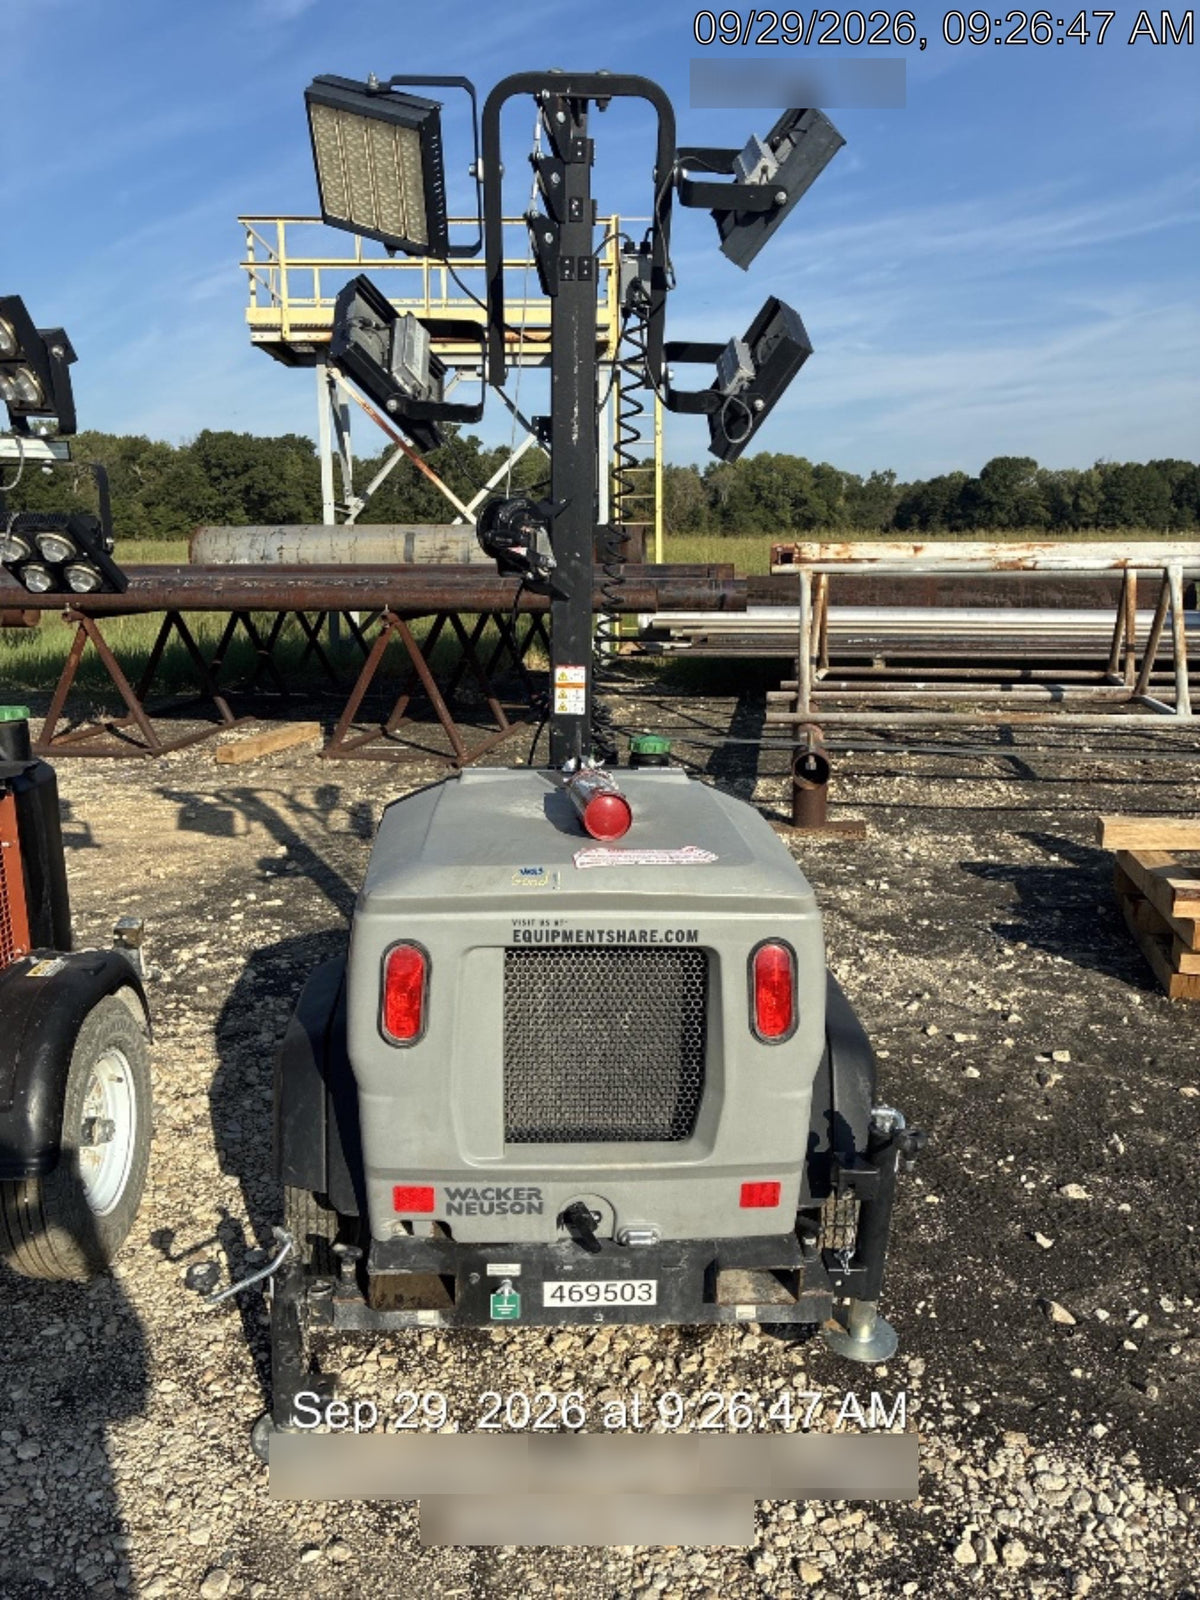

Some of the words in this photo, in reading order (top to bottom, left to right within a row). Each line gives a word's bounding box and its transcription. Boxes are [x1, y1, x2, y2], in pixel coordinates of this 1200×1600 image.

[511, 919, 535, 927] VISIT
[512, 929, 699, 944] EQUIPMENTSHARE.COM
[444, 1187, 543, 1201] WACKER
[446, 1201, 544, 1216] NEUSON
[550, 1283, 652, 1303] 469503
